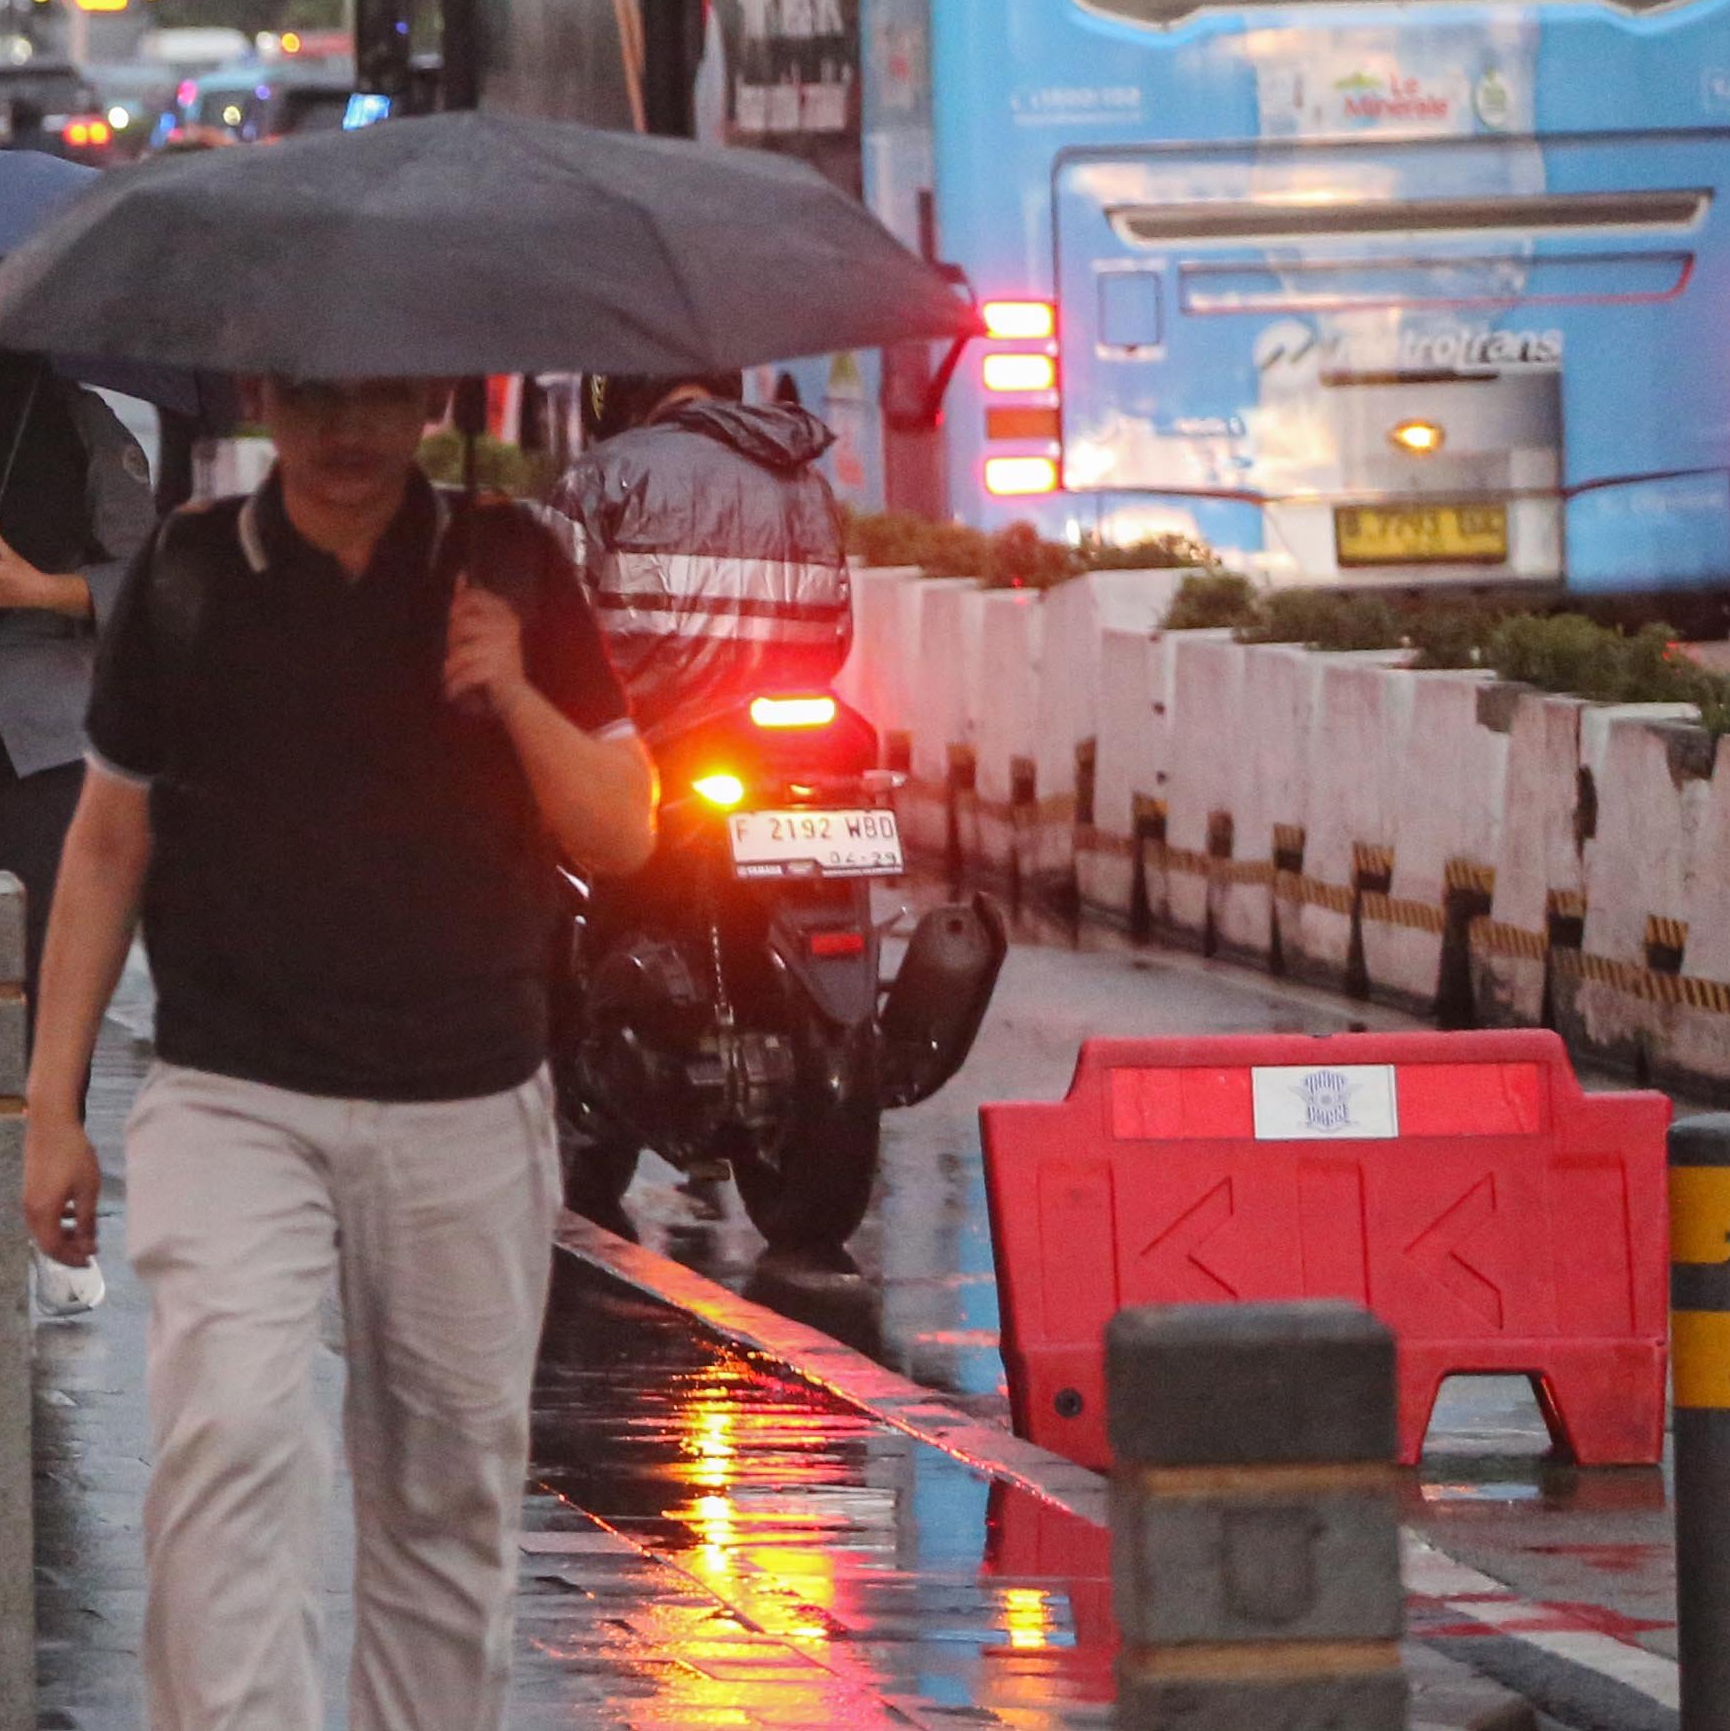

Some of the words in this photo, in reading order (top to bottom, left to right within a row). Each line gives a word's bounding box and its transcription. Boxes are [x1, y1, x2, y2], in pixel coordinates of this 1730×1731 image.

[736, 819, 749, 843] F
[770, 817, 832, 841] 2192
[847, 816, 896, 840] WBD
